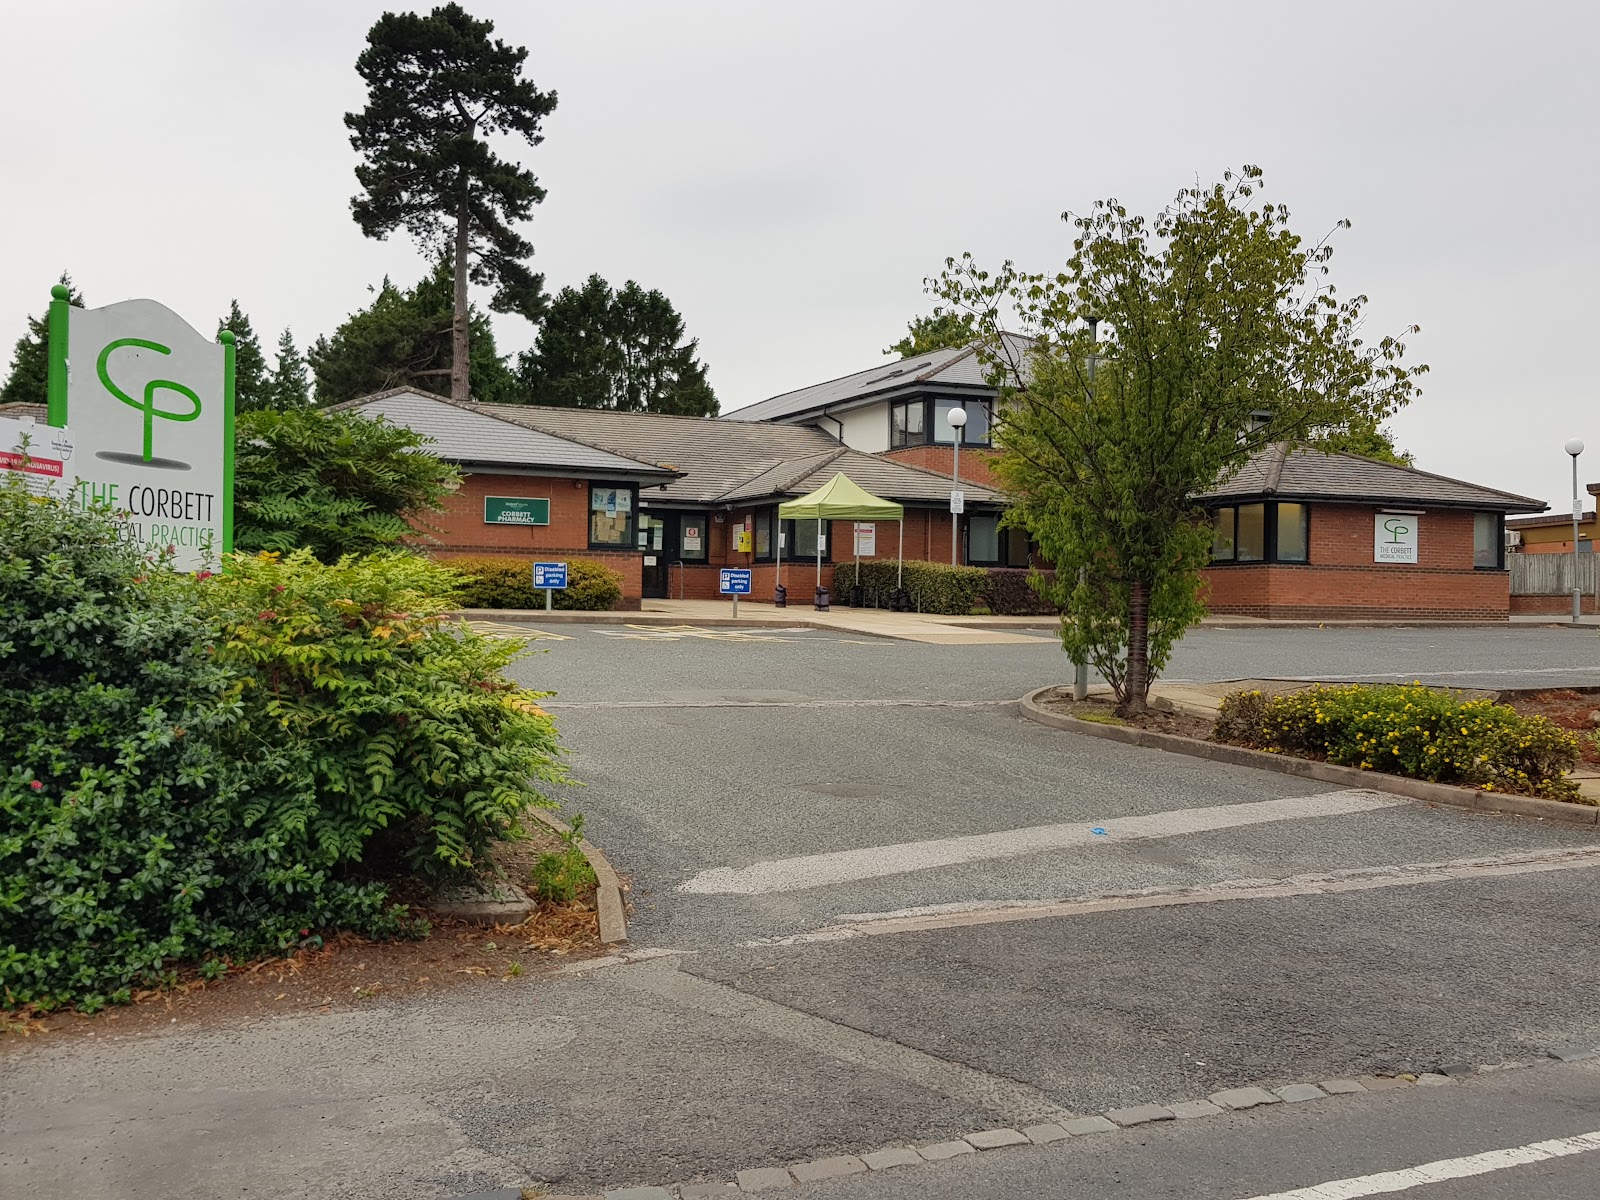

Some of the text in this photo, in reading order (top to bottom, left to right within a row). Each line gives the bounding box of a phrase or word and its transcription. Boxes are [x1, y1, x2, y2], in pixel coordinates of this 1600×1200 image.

[80, 480, 119, 510] THE
[129, 485, 214, 521] CORBETT
[501, 510, 531, 518] CORBETT
[497, 515, 535, 523] PHARMACY
[1380, 546, 1412, 555] THE CORBETT
